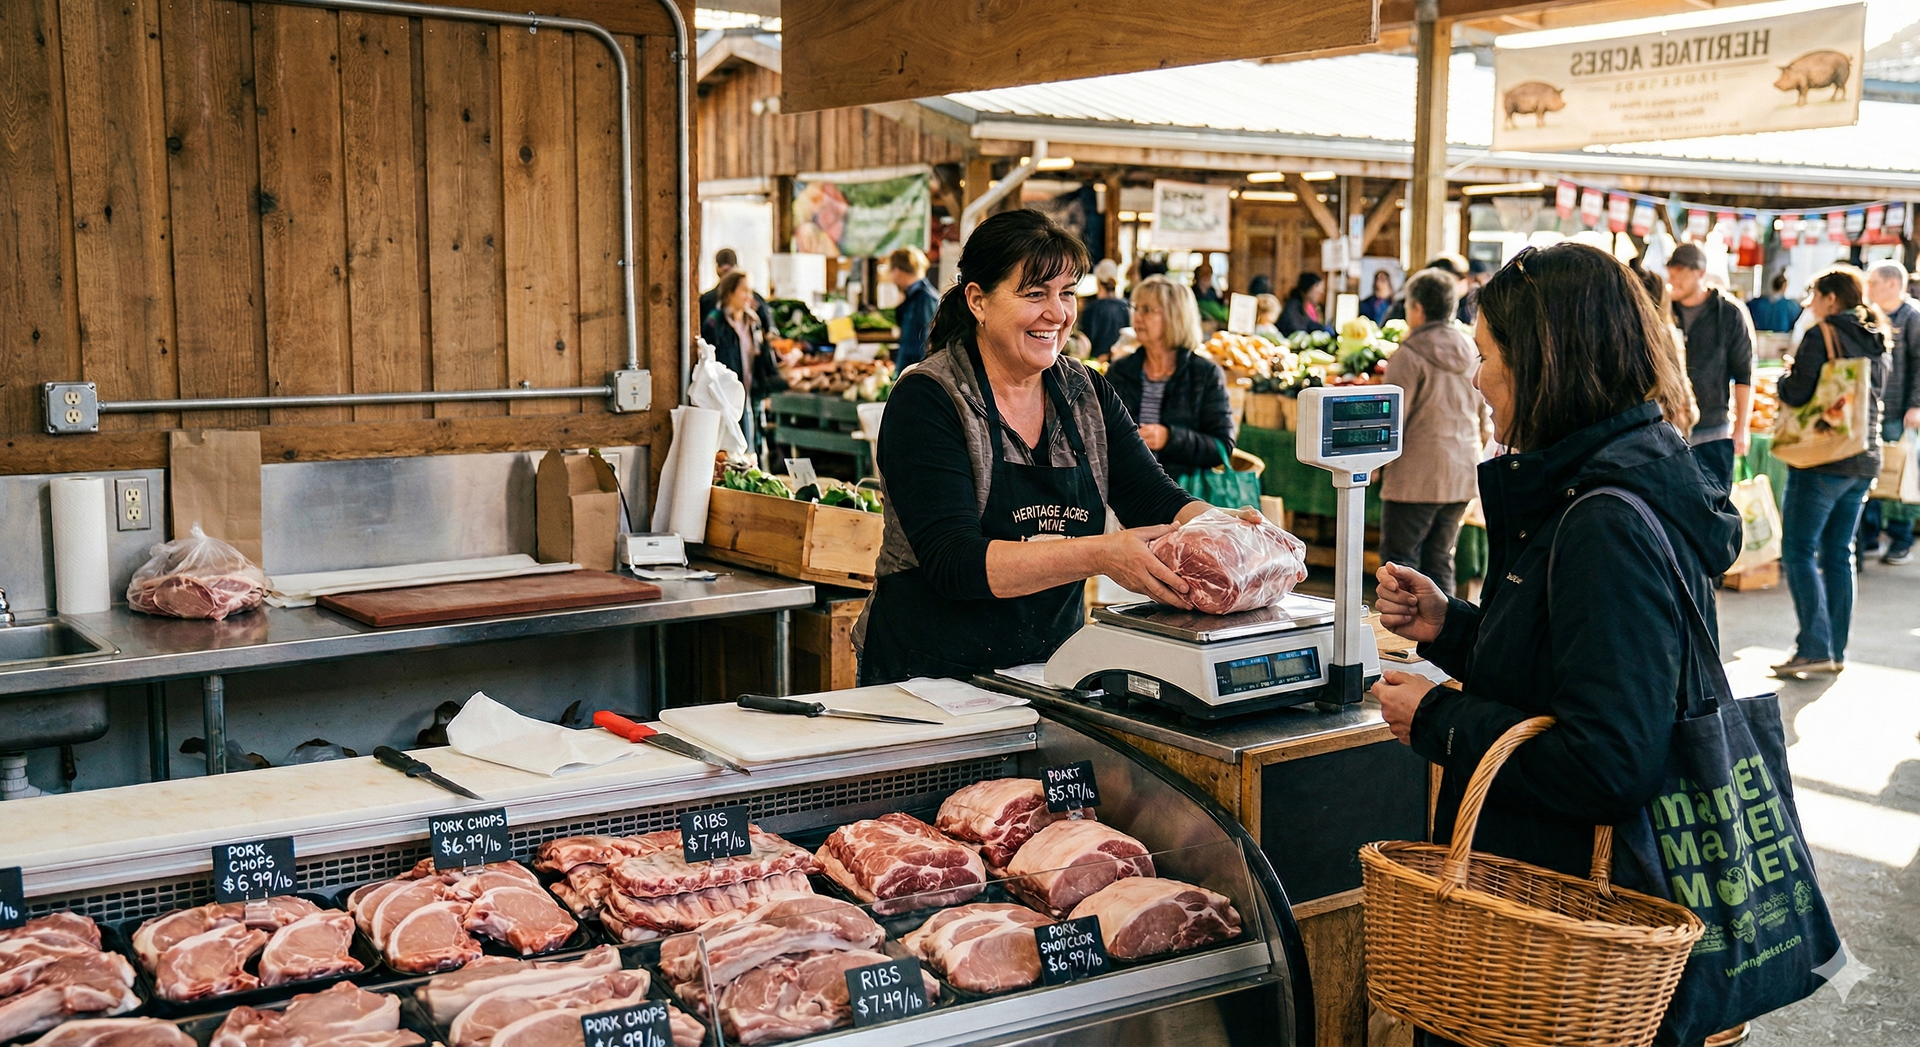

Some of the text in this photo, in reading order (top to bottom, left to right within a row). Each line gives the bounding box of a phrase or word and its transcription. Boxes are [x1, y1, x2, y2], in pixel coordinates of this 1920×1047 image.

[1012, 505, 1089, 523] HERITAGE ACRES
[1048, 782, 1095, 803] $5.99/lb
[432, 814, 504, 835] PORK CHOPS
[693, 812, 728, 831] RIBS
[228, 843, 265, 860] PORK
[441, 834, 501, 856] $6.99/lb
[688, 830, 746, 853] $7.49/lb
[222, 870, 293, 894] $6.99/lb
[1048, 923, 1079, 939] PORK
[1048, 948, 1102, 975] $6.99/lb
[860, 965, 901, 991] RIBS
[857, 987, 923, 1018] $7.49/lb
[584, 1006, 667, 1035] PORK CHOPS
